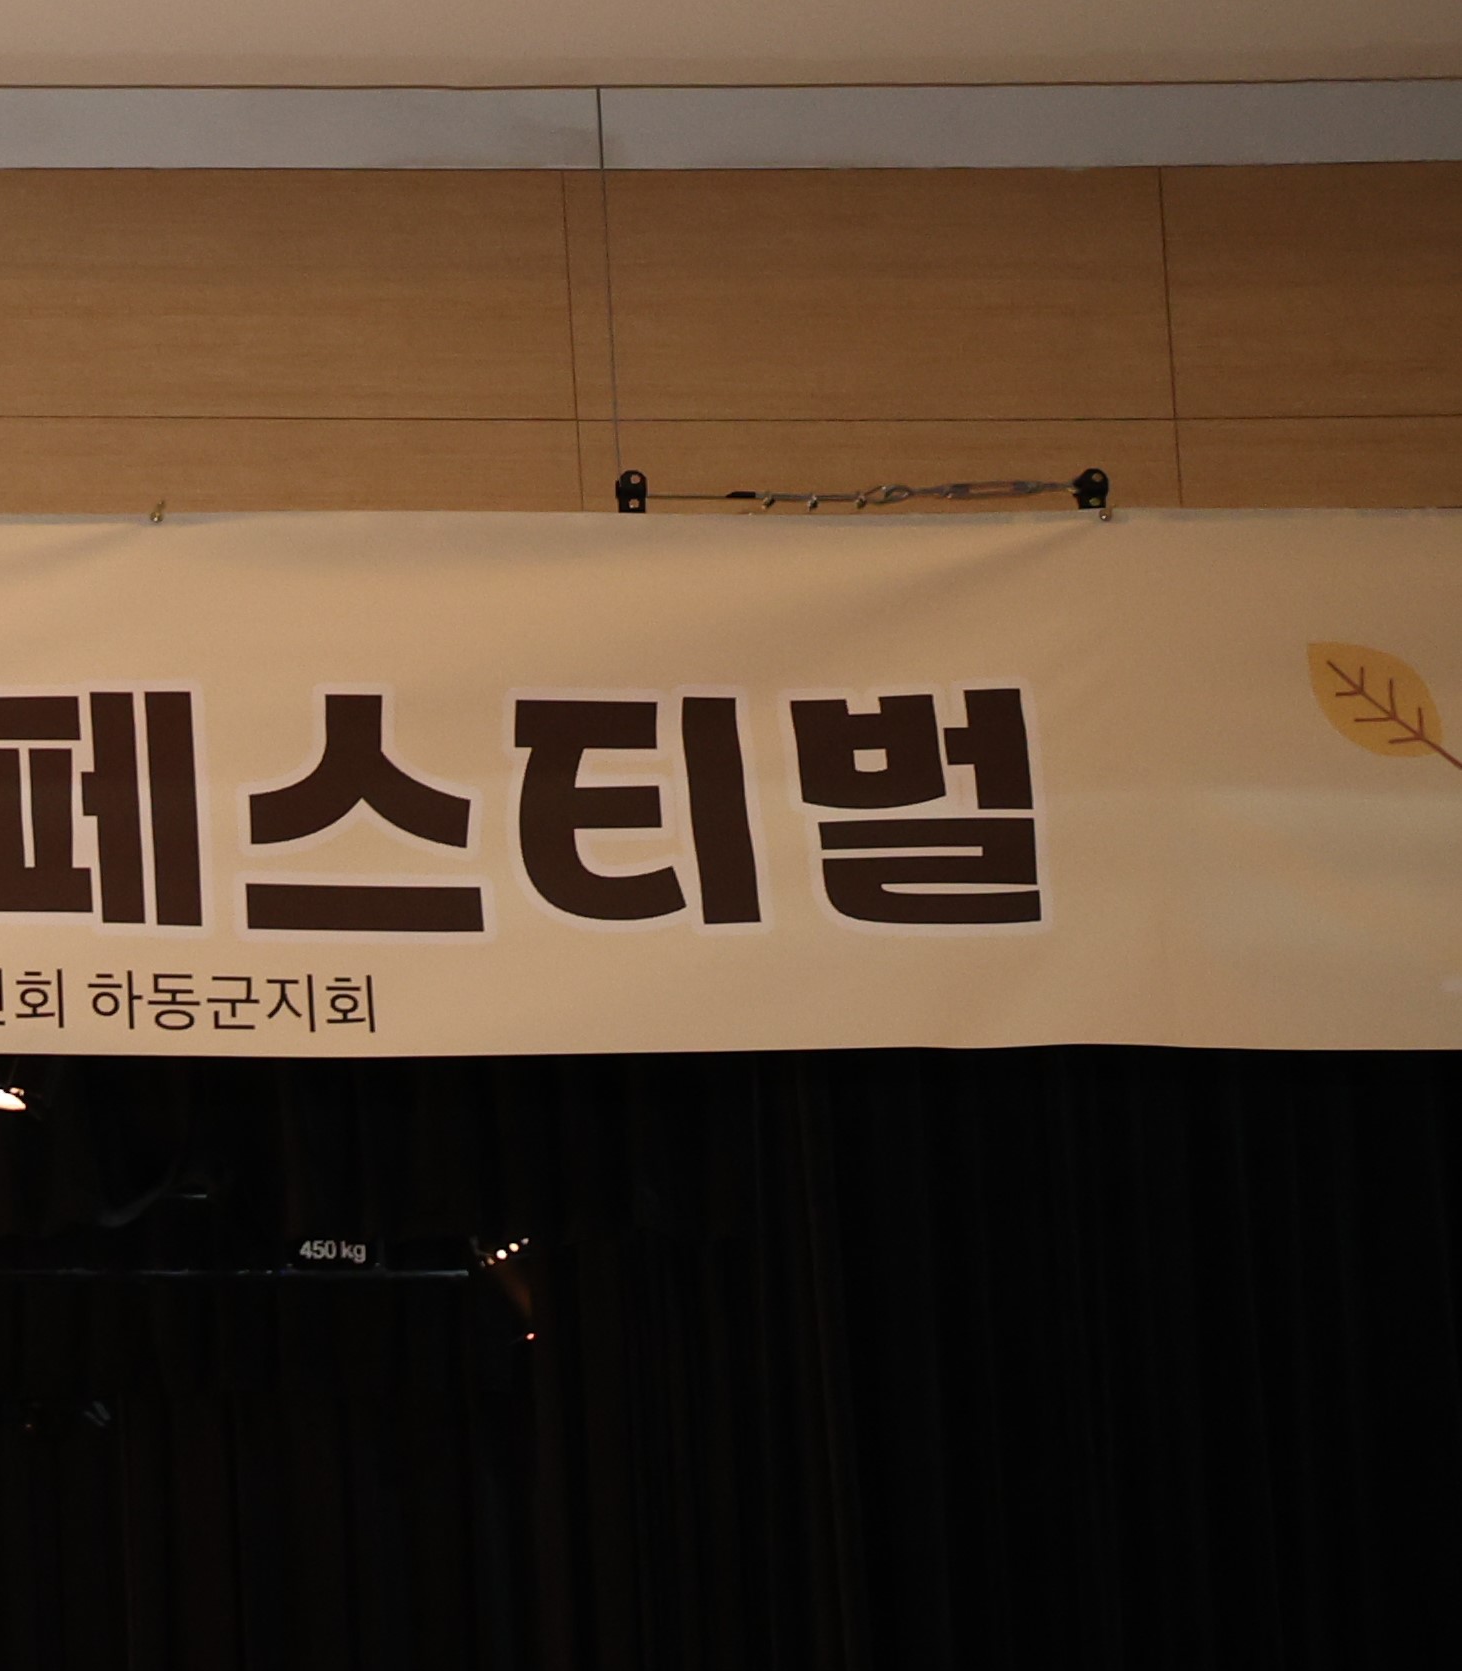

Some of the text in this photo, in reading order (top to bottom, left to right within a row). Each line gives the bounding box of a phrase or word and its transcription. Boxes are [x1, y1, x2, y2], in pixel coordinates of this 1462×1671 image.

[88, 971, 375, 1033] 하동군지회
[300, 1241, 365, 1263] 450 kg
